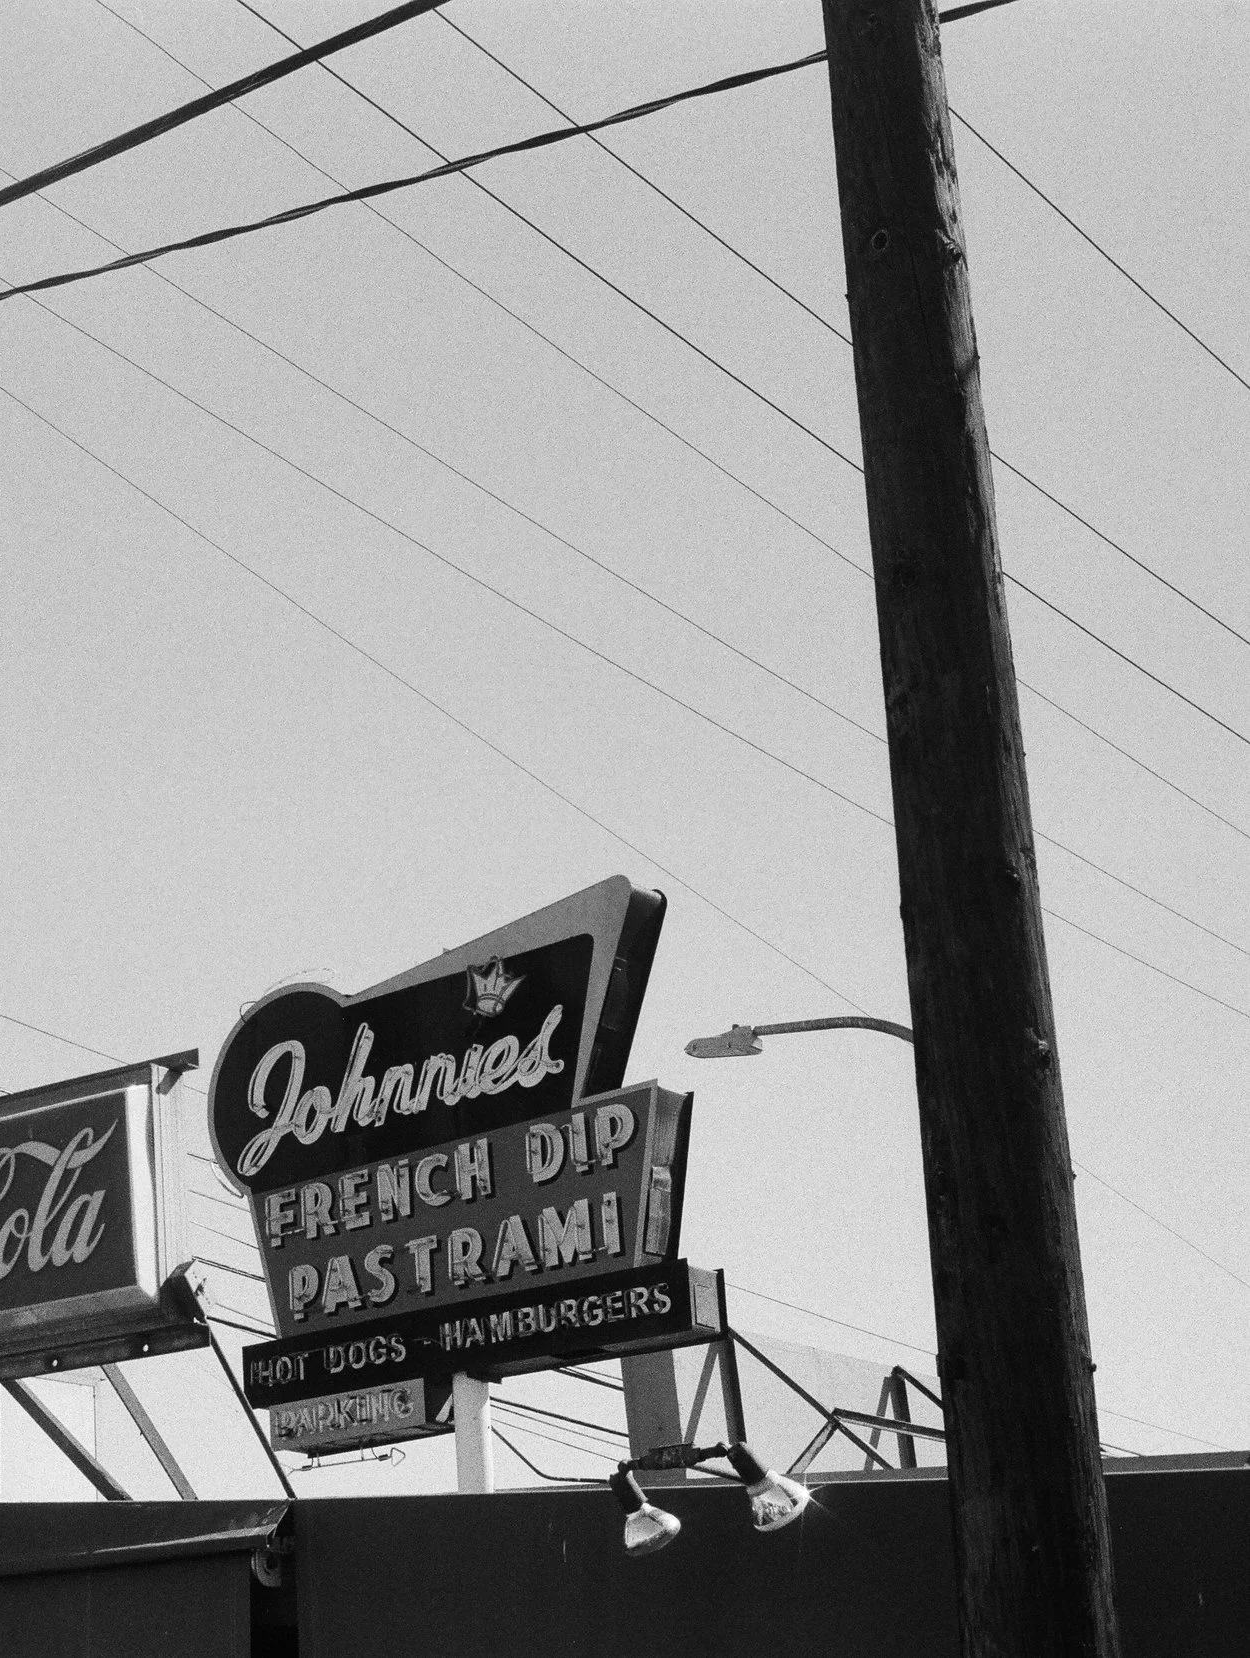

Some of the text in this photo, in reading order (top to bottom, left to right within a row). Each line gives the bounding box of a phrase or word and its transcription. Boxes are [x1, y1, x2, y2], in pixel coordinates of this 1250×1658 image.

[265, 1103, 636, 1248] FRENCH DIP
[288, 1191, 623, 1321] PASTRAMI
[250, 1353, 309, 1387] HOT
[323, 1334, 406, 1374] DOGS
[439, 1283, 672, 1351] HAMBURGERS
[275, 1388, 415, 1440] PARKING
